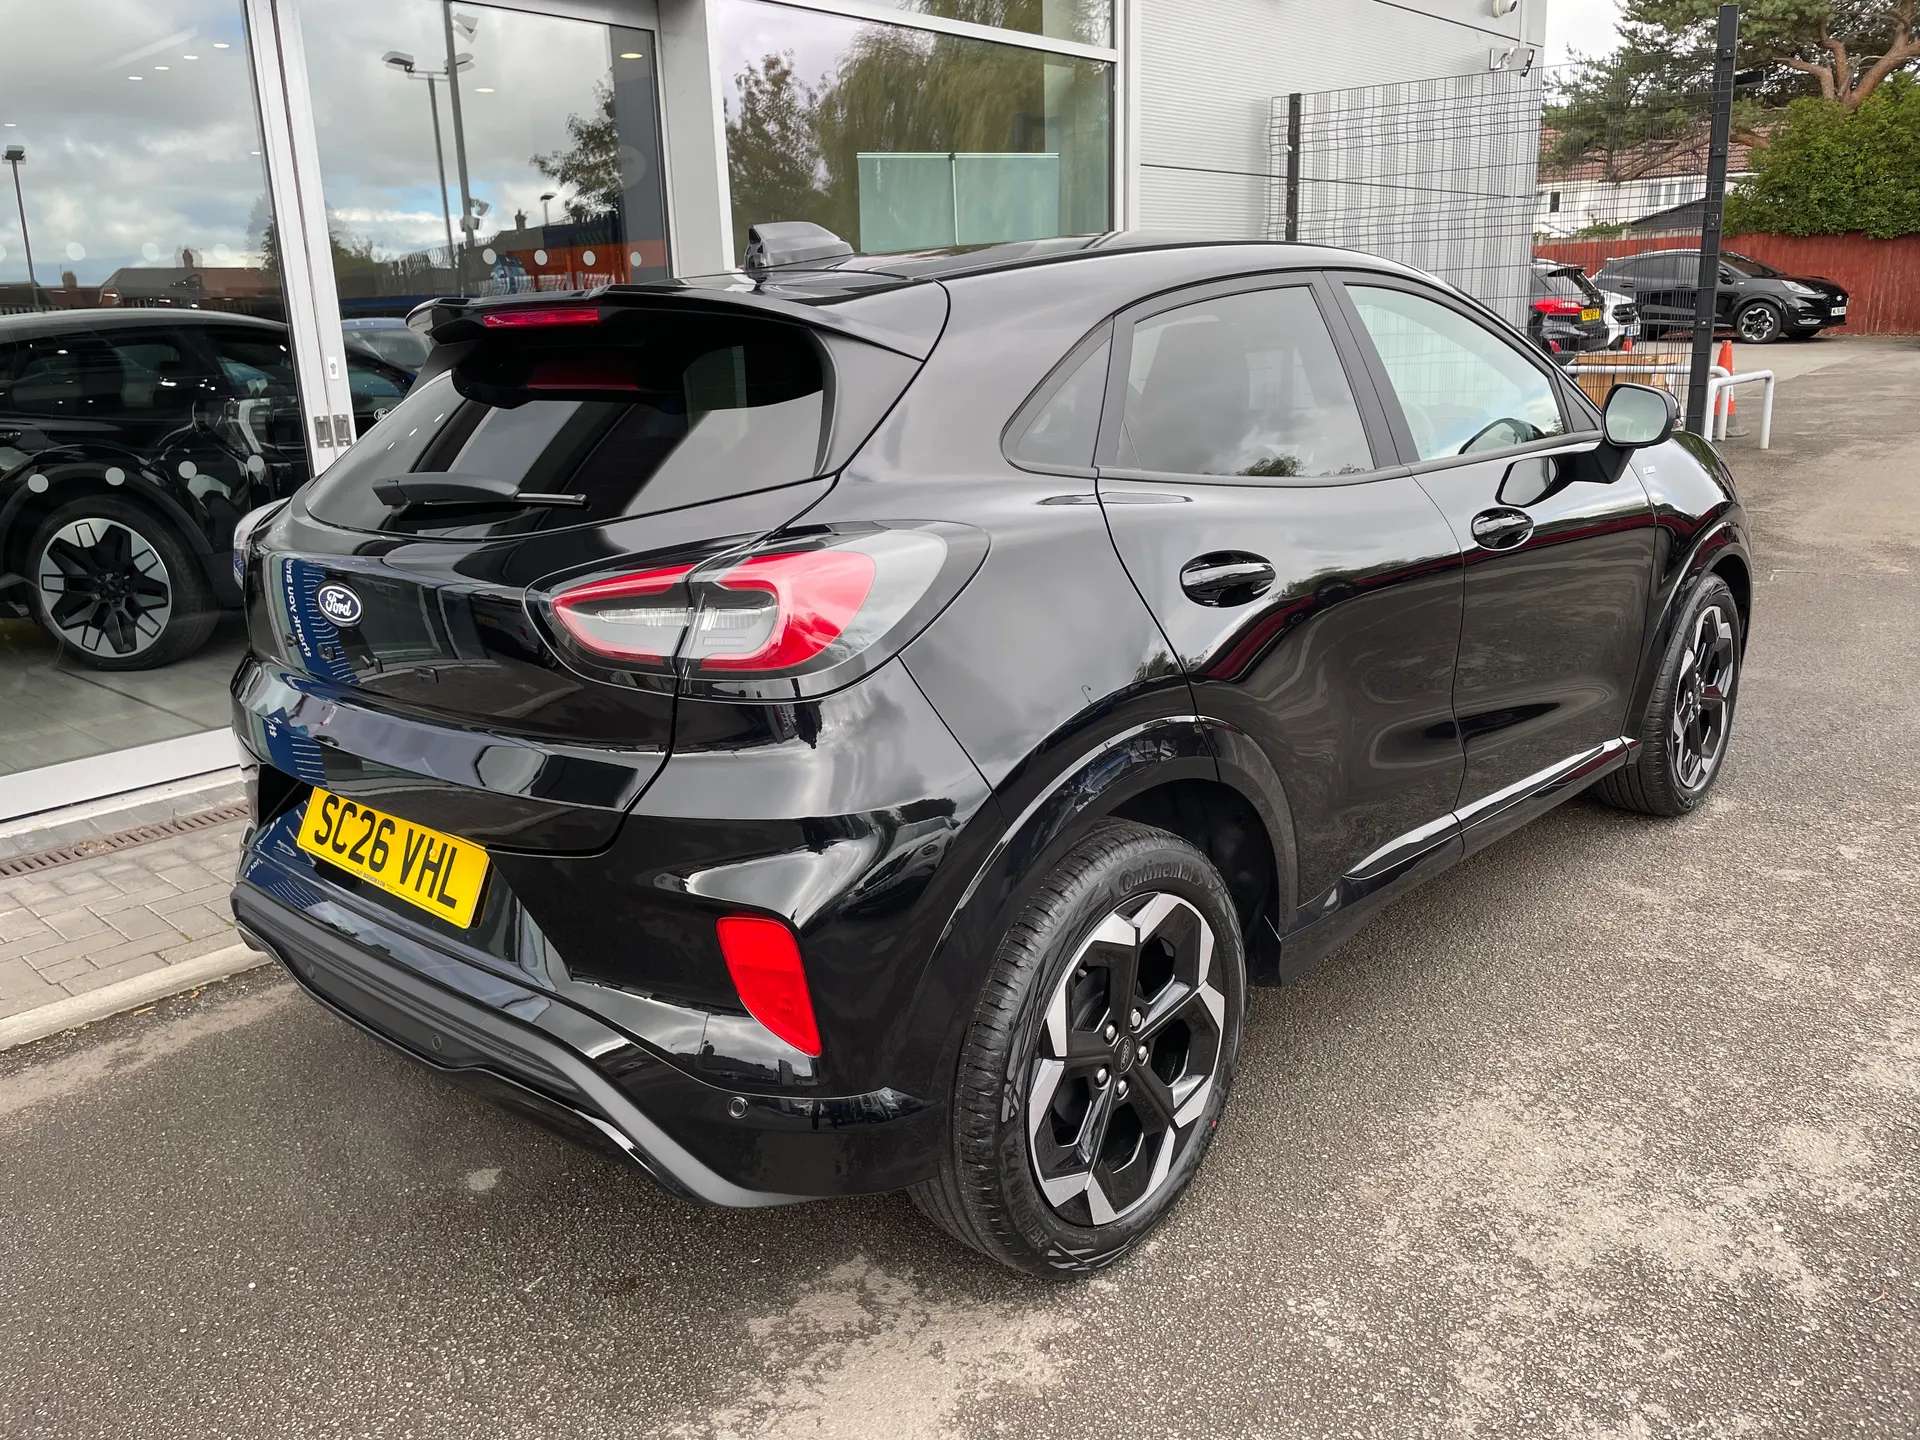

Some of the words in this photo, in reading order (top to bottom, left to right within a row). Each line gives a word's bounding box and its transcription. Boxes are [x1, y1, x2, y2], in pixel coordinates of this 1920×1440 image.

[325, 590, 352, 617] Ford
[314, 794, 396, 873] SC26
[400, 828, 458, 909] VHL
